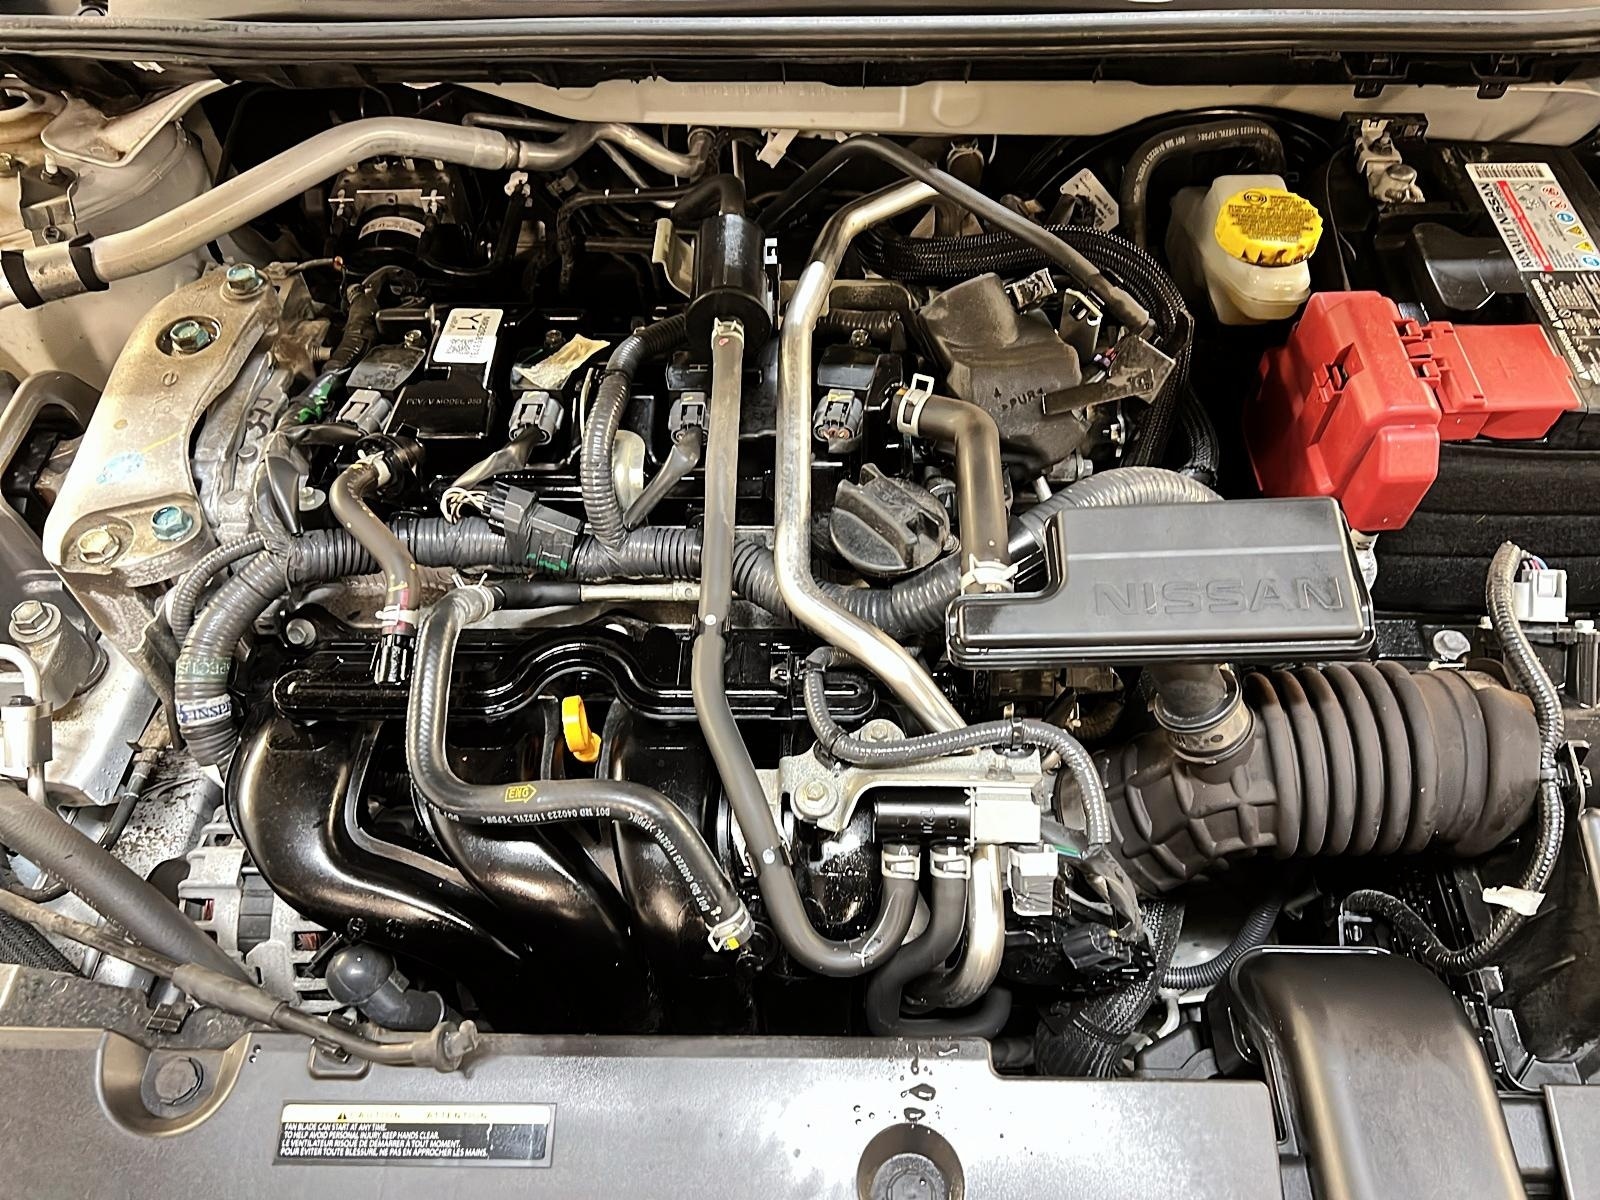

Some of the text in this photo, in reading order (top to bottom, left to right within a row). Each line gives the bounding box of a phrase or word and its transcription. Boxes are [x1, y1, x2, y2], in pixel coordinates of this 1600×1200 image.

[1480, 182, 1512, 226] NISSAN
[457, 312, 483, 330] Y1
[1095, 576, 1345, 616] NISSAN
[508, 787, 531, 800] ENG
[548, 808, 578, 820] 040223
[596, 807, 611, 817] DOT
[672, 854, 694, 882] 040223
[695, 895, 711, 912] DOT
[284, 1122, 297, 1131] FAN
[298, 1122, 317, 1131] BLADE
[317, 1122, 331, 1131] CAN
[331, 1122, 350, 1131] START
[358, 1122, 372, 1131] ANY
[284, 1130, 293, 1139] TO
[293, 1130, 309, 1139] HELP
[309, 1130, 328, 1139] AVOID
[328, 1130, 359, 1139] PERSONAL
[382, 1130, 398, 1139] KEEP
[397, 1130, 419, 1139] HANDS
[281, 1139, 291, 1148] LE
[290, 1139, 333, 1148] VENTILATEUR
[334, 1139, 359, 1148] RISQUE
[359, 1139, 369, 1148] DE
[411, 1139, 430, 1148] TOUT
[280, 1147, 300, 1156] POUR
[323, 1147, 345, 1156] TOUTE
[379, 1147, 389, 1156] NE
[389, 1147, 402, 1156] PAS
[402, 1147, 412, 1156] EN
[412, 1147, 452, 1156] APPROCHER
[452, 1147, 465, 1156] LES
